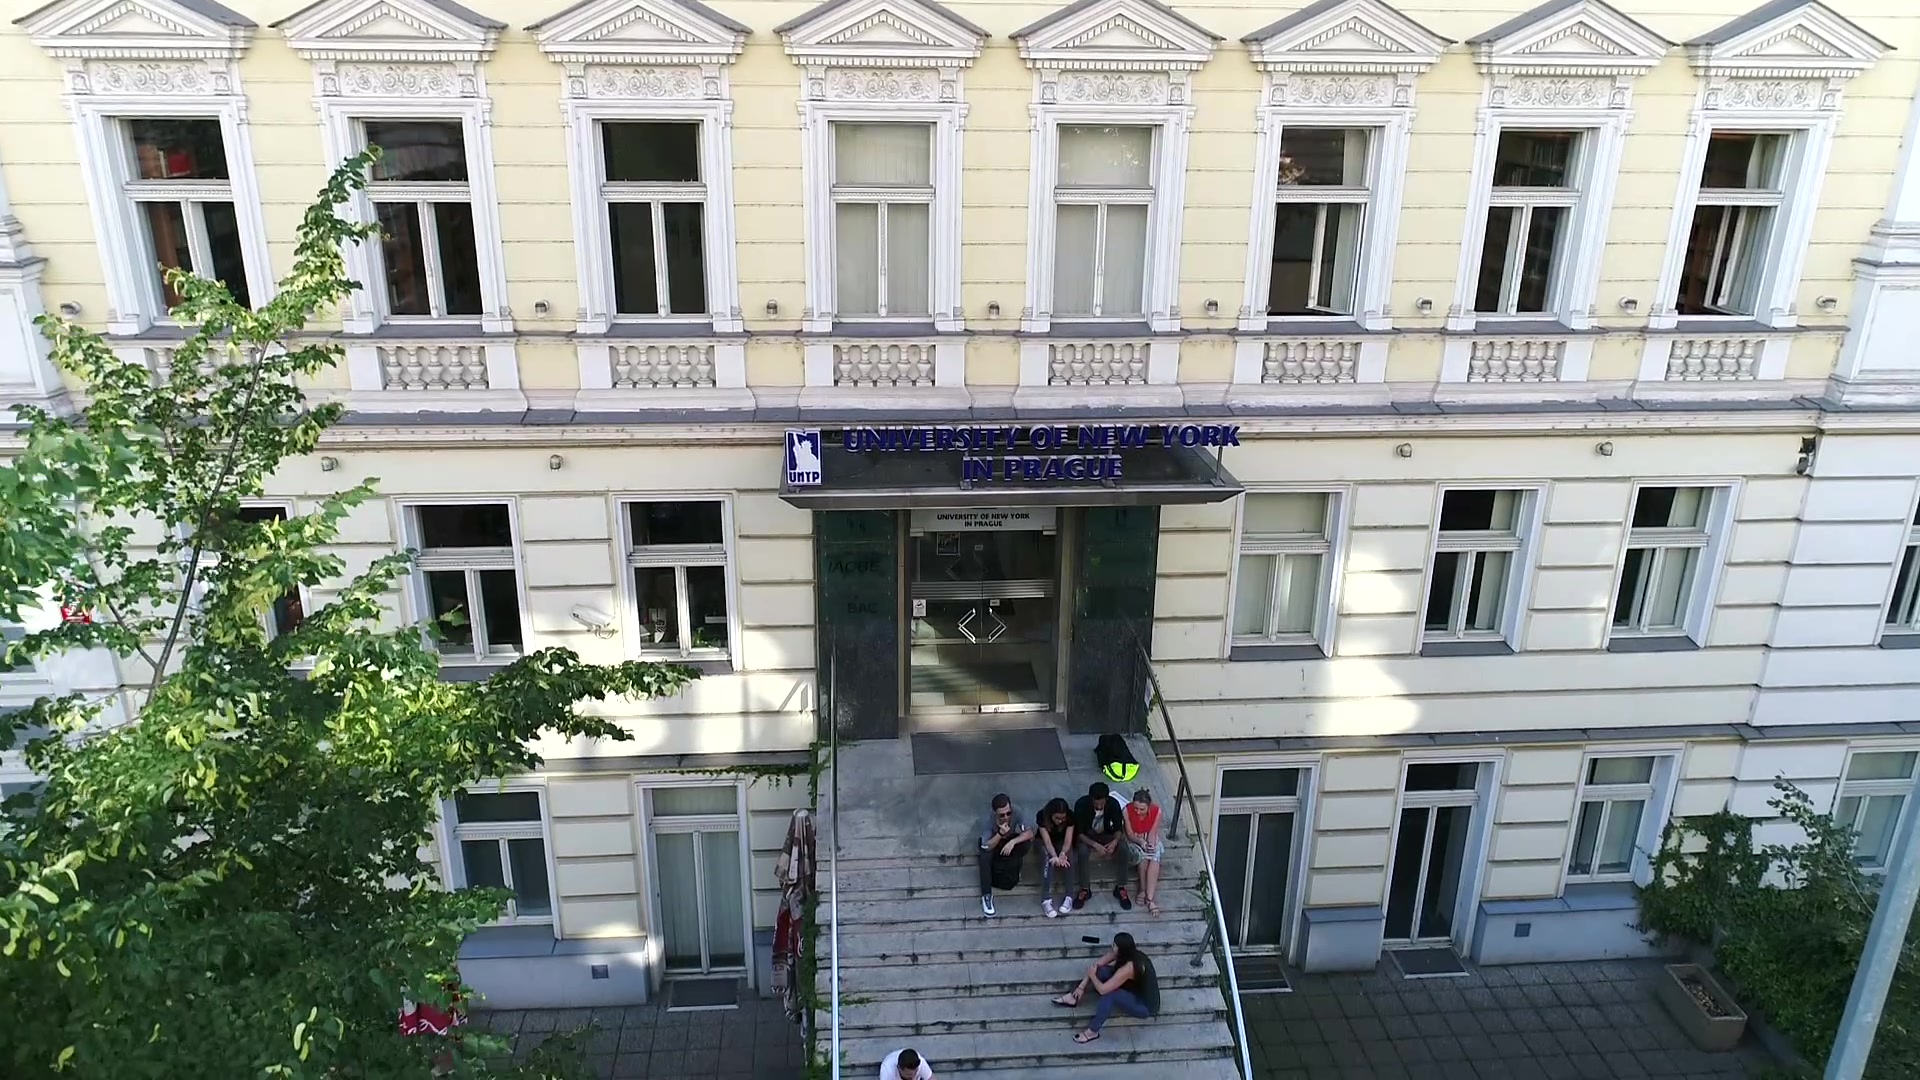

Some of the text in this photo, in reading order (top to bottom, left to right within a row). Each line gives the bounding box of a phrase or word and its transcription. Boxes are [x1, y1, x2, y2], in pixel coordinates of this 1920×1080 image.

[843, 424, 1240, 452] UNIVERSITY OF NEW YORK
[963, 454, 1122, 482] IN PRAGUE
[991, 512, 1009, 520] NEW
[1010, 512, 1030, 520] YORK
